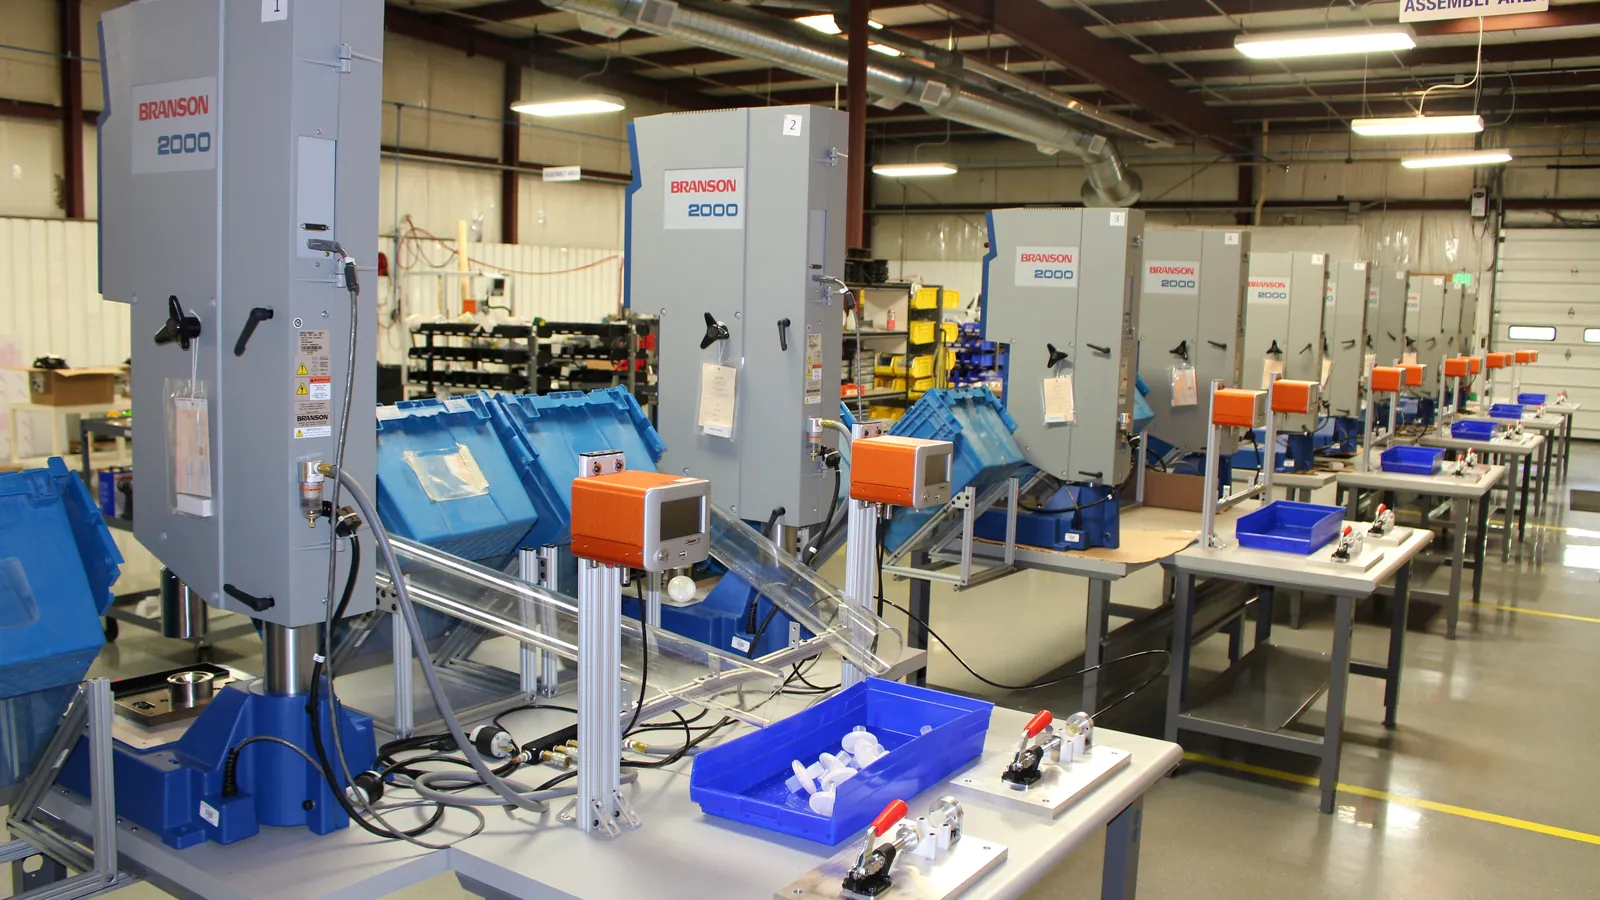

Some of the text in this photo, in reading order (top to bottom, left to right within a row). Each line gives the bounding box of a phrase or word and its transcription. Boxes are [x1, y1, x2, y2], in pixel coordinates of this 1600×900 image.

[138, 95, 209, 121] BRANSON
[790, 119, 796, 130] 2
[157, 131, 211, 156] 2000
[671, 179, 736, 193] BRANSON
[688, 203, 738, 217] 2000
[1114, 214, 1120, 223] 3
[1020, 253, 1073, 263] BRANSON
[1034, 269, 1074, 280] 2000
[1149, 266, 1195, 275] BRANSON
[1161, 279, 1196, 288] 2000
[1258, 291, 1287, 299] 2000
[297, 414, 328, 422] BRANSON
